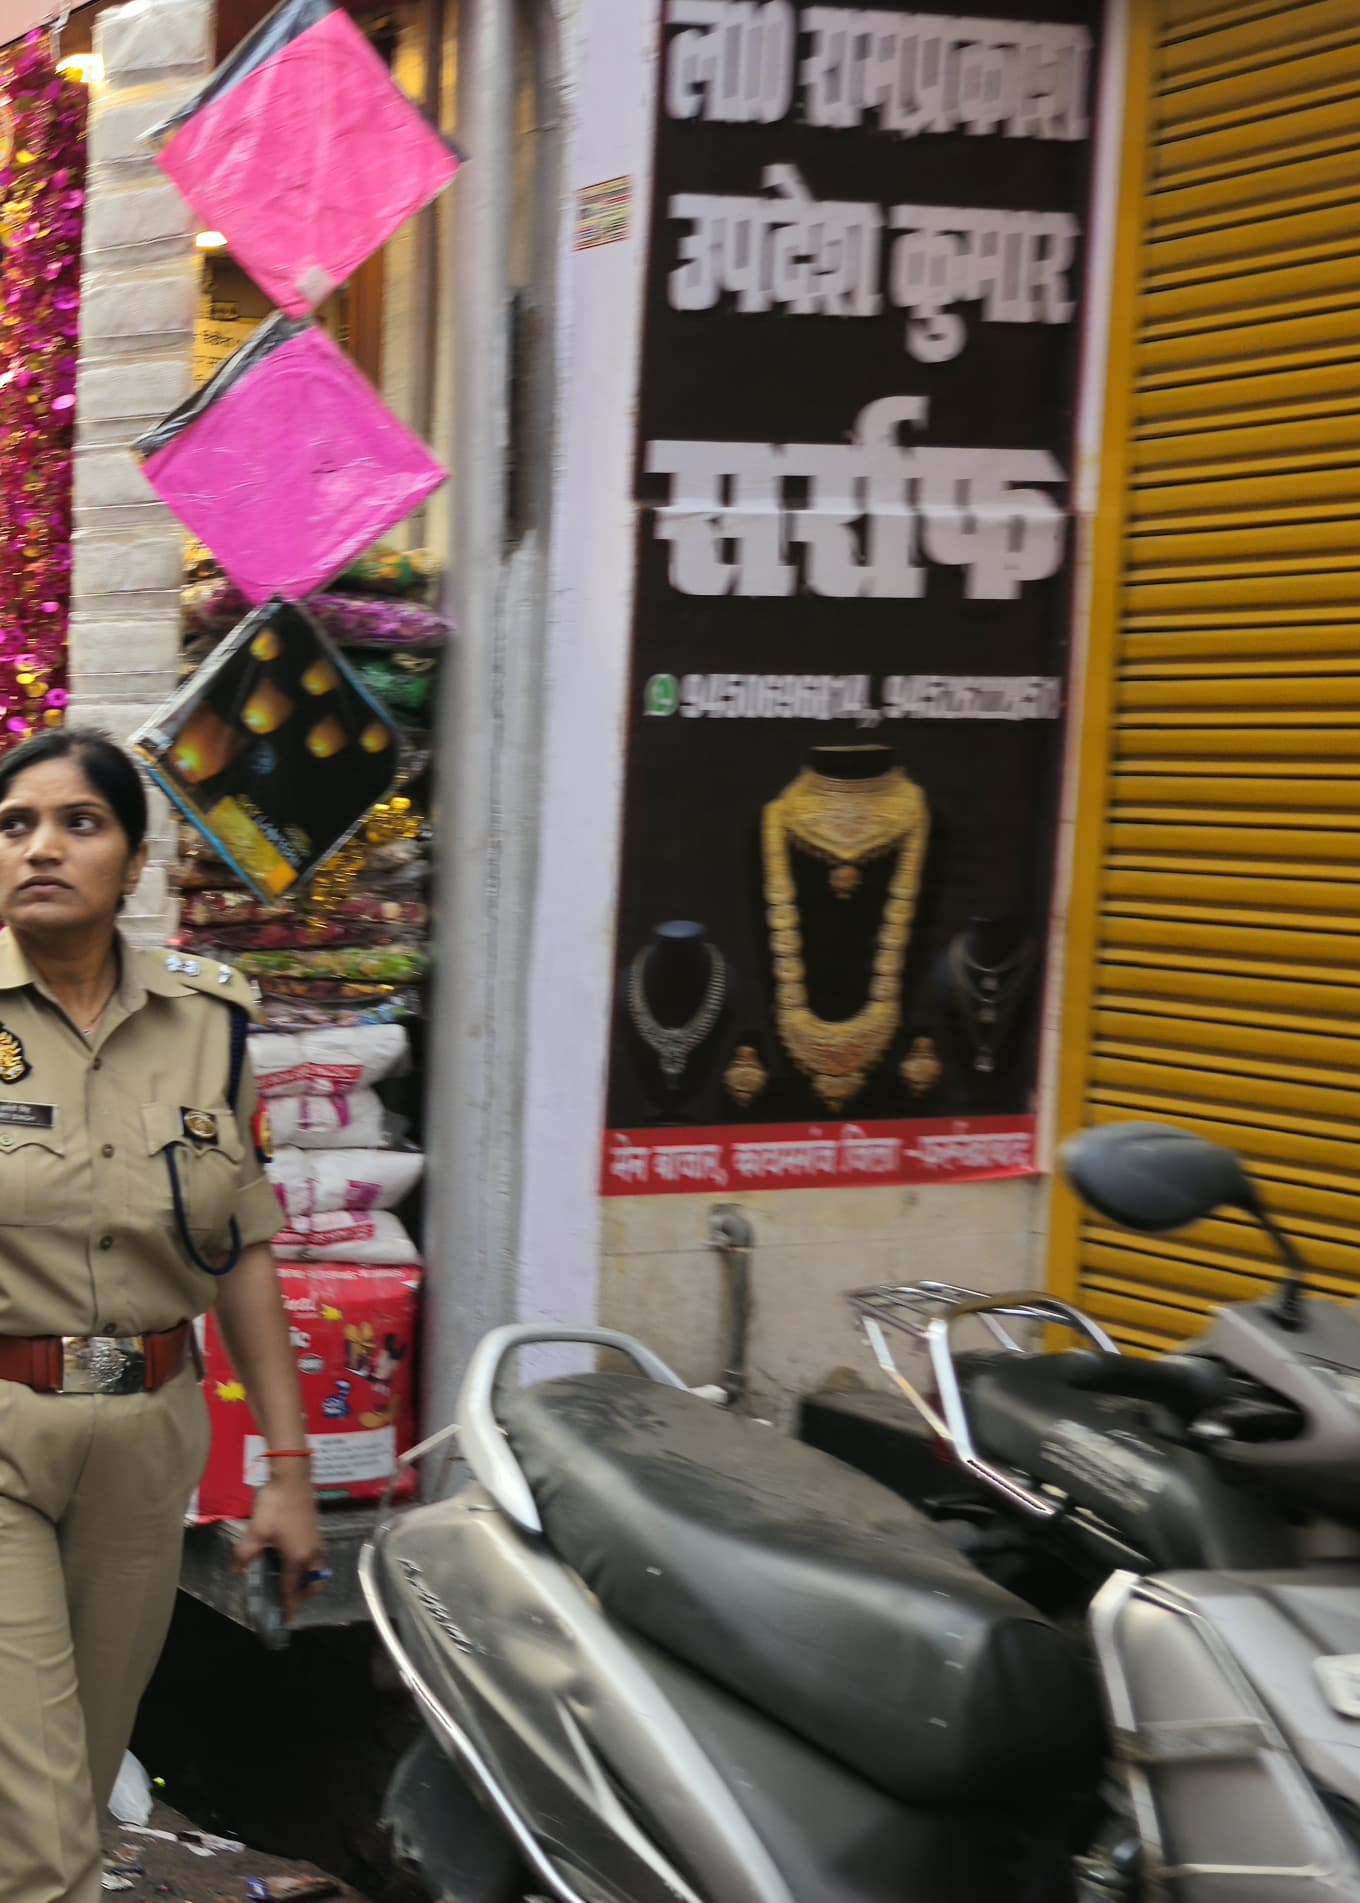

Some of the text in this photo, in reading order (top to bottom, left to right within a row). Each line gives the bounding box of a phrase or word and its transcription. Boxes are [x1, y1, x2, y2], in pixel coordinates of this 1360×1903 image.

[667, 163, 1077, 363] उपदेश कुमार
[644, 395, 1072, 600] सर्राफ
